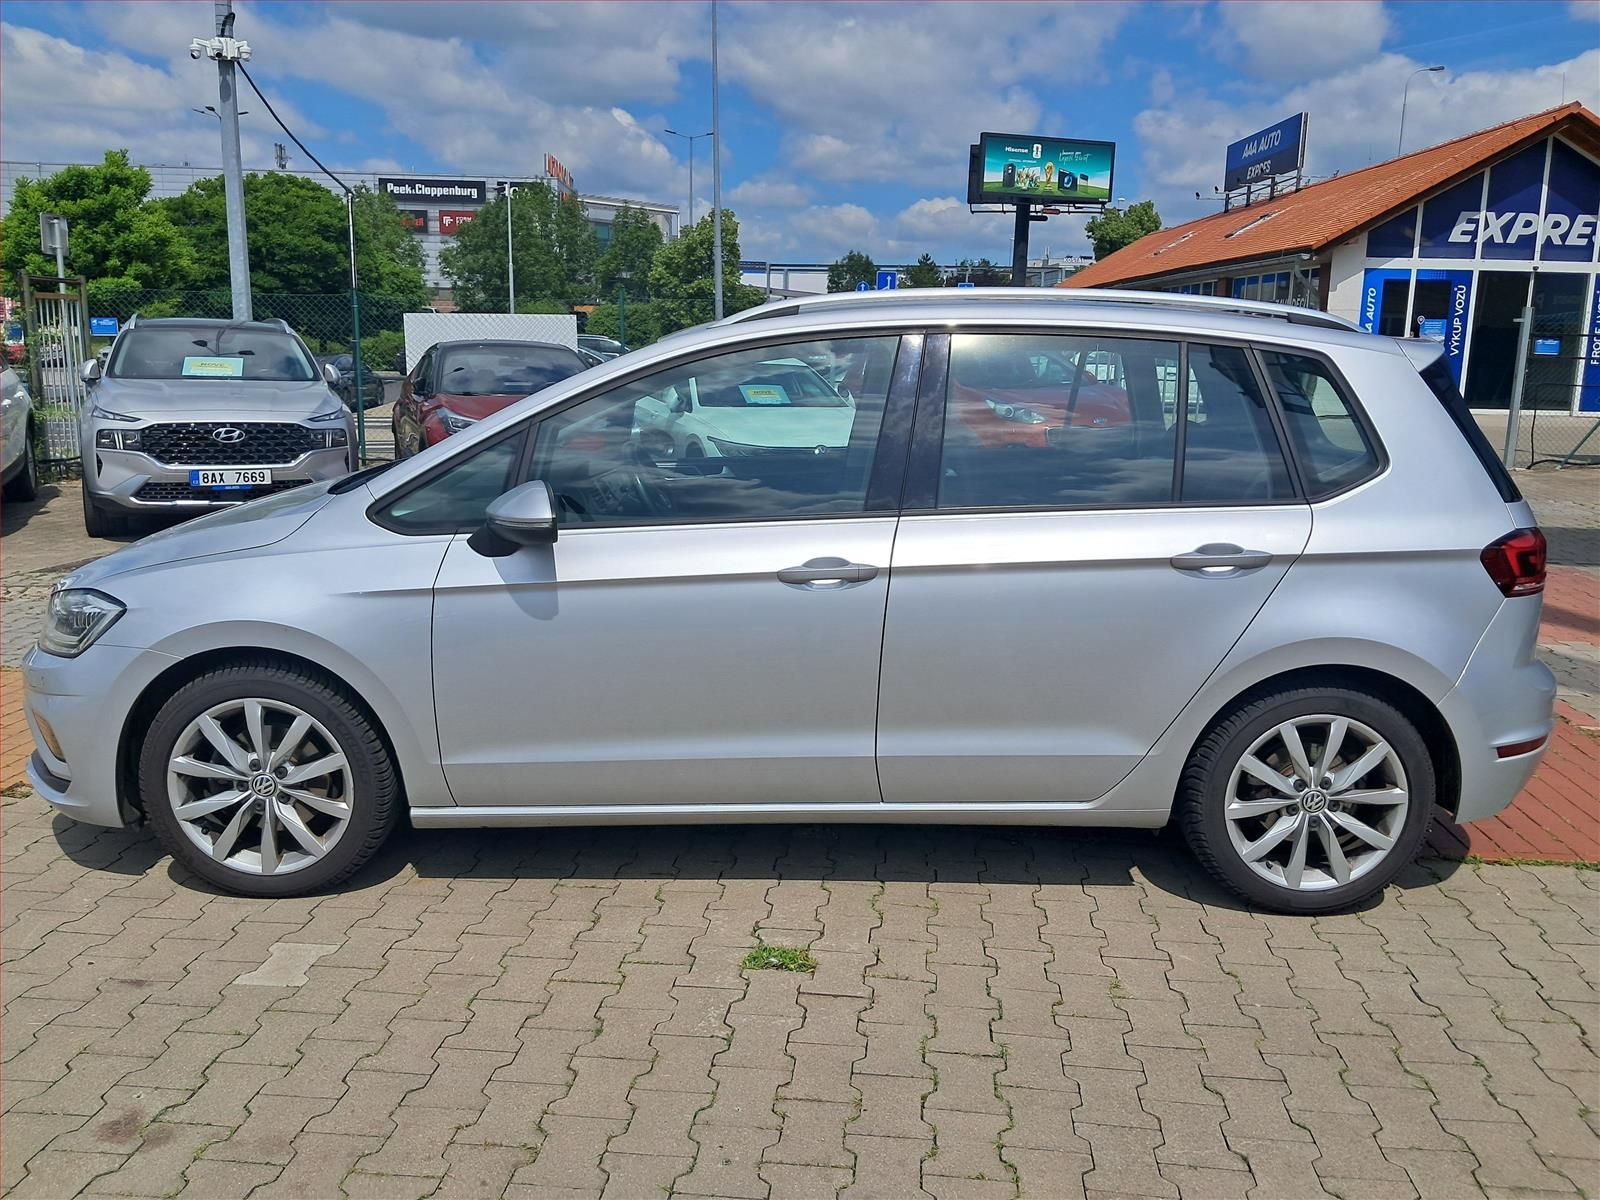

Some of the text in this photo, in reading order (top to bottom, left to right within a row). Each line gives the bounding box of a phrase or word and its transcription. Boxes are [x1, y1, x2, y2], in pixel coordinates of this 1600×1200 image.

[1242, 129, 1281, 160] AAA AUTO
[1447, 210, 1600, 246] EXPRE
[1366, 287, 1377, 321] AUTO
[1448, 285, 1467, 356] VÝKUP VOZŮ
[202, 472, 225, 484] 8AX
[234, 471, 266, 482] 7669
